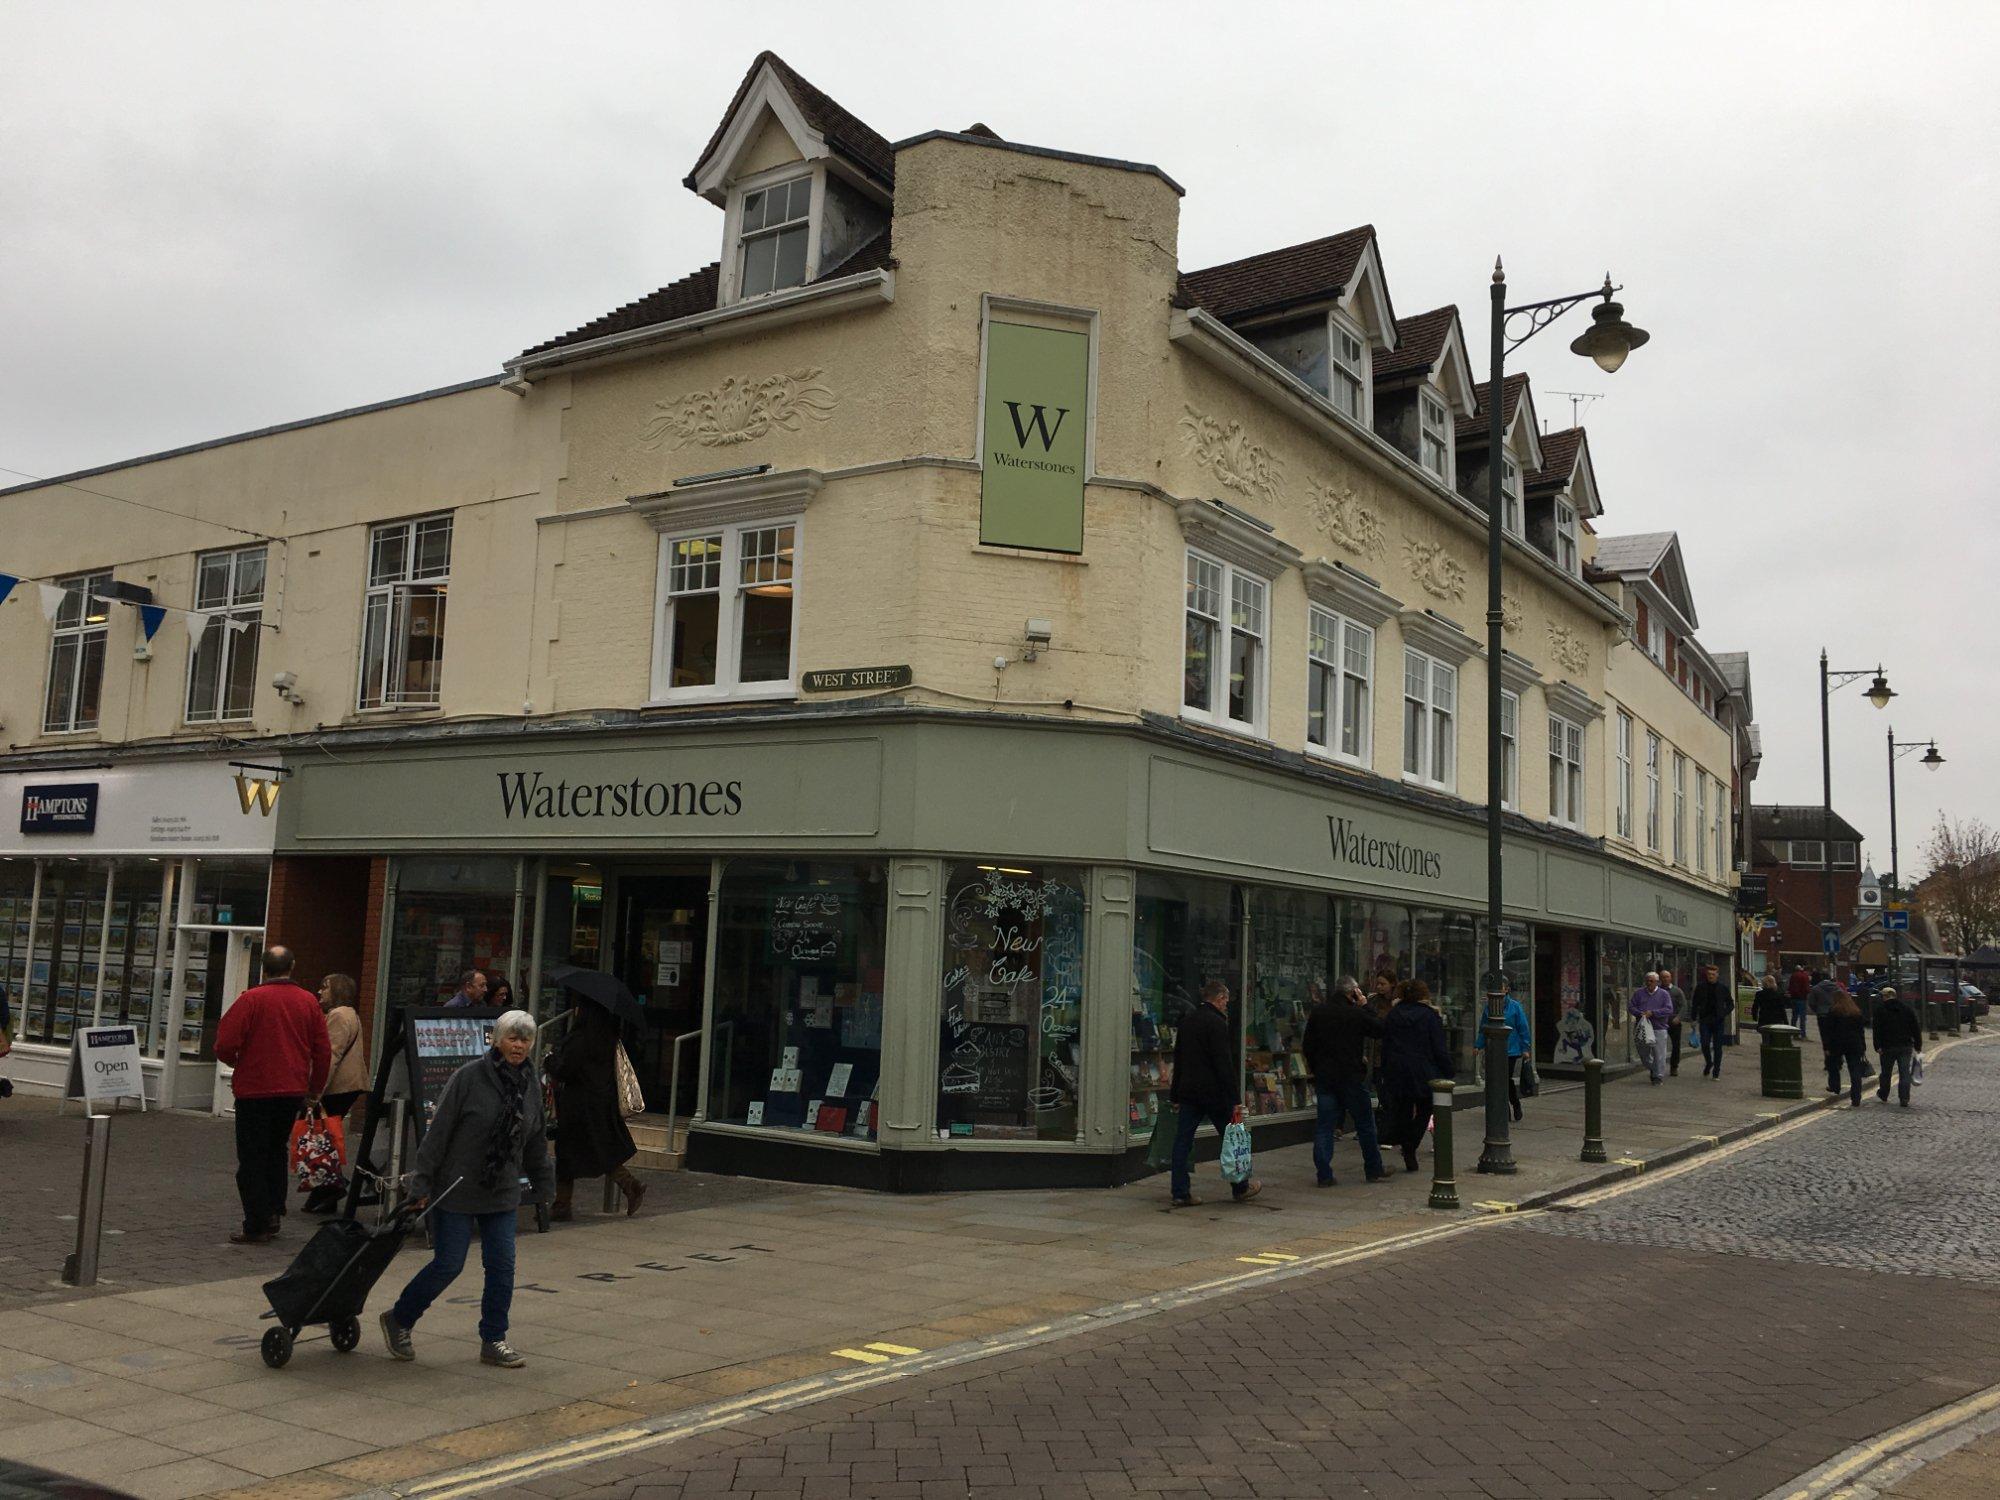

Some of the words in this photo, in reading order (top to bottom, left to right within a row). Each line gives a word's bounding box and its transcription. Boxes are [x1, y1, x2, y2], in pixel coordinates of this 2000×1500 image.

[1003, 401, 1070, 452] W
[993, 452, 1076, 475] Waterstones
[812, 673, 847, 687] WEST
[851, 669, 901, 685] STREET
[25, 796, 88, 821] HAMPTONS
[232, 775, 283, 817] W
[497, 771, 742, 819] Waterstones
[1326, 815, 1441, 879] Waterstones
[989, 925, 1043, 951] New
[989, 956, 1039, 995] Cafe
[94, 1061, 129, 1076] Open
